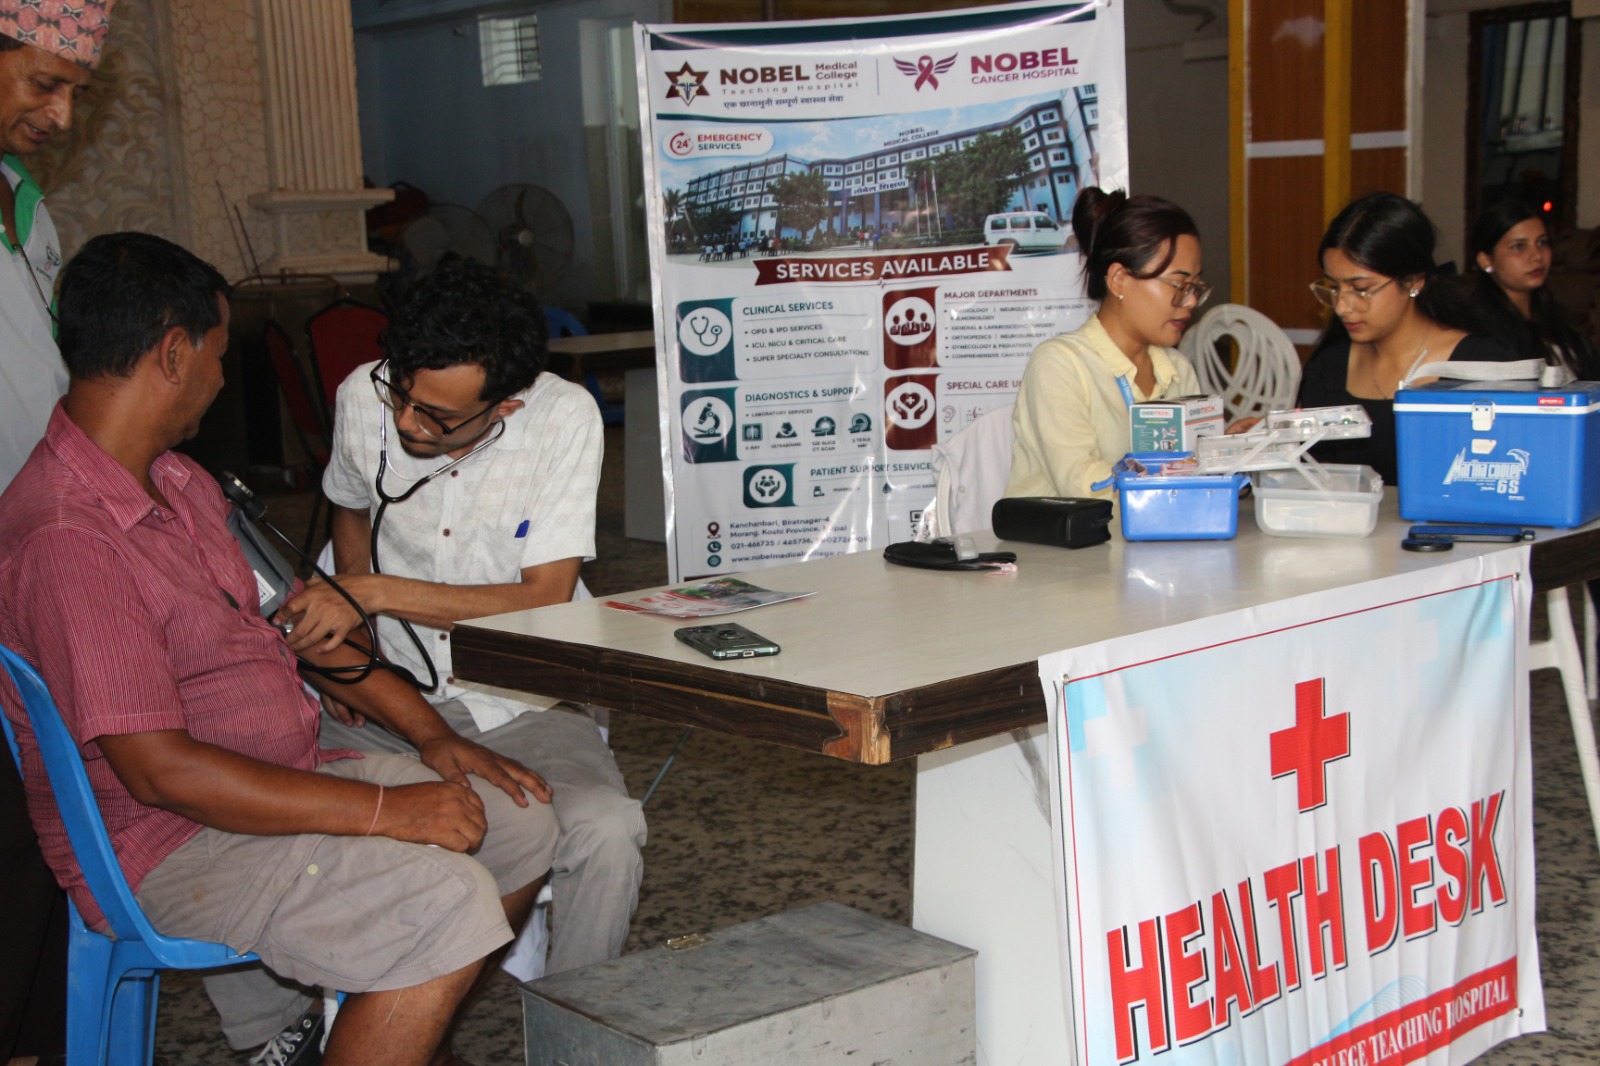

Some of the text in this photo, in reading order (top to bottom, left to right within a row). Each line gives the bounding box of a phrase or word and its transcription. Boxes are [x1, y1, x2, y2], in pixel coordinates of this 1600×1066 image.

[815, 61, 857, 71] Medical
[970, 47, 1078, 74] NOBEL
[720, 65, 810, 85] NOBEL
[816, 70, 857, 81] College
[971, 66, 1079, 85] CANCER HOSPITAL
[722, 81, 859, 96] Teaching Hospital
[697, 133, 762, 142] EMERGENCY
[883, 129, 940, 147] MEDICAL COLLEGE
[899, 126, 925, 136] NOBEL
[698, 142, 742, 151] SERVICES
[776, 252, 990, 280] SERVICES AVAILABLE
[944, 288, 1038, 299] MAJOR DEPARTMENTS
[743, 301, 834, 316] CLINICAL SERVICES
[751, 327, 767, 335] OPD
[790, 324, 823, 332] SERVICES
[795, 337, 825, 345] CRITICAL
[753, 349, 869, 363] SUPER SPECIALTY CONSULTATIONS
[947, 381, 983, 390] SPECIAL
[985, 380, 1010, 389] CARE
[745, 390, 809, 403] DIAGNOSTICS
[812, 389, 818, 398] &
[810, 466, 847, 477] PATIENT
[893, 462, 932, 472] SERVICE
[1107, 789, 1507, 1066] HEALTH DESK
[1368, 1006, 1442, 1064] TEACHING
[1445, 975, 1510, 1030] HOSPITAL
